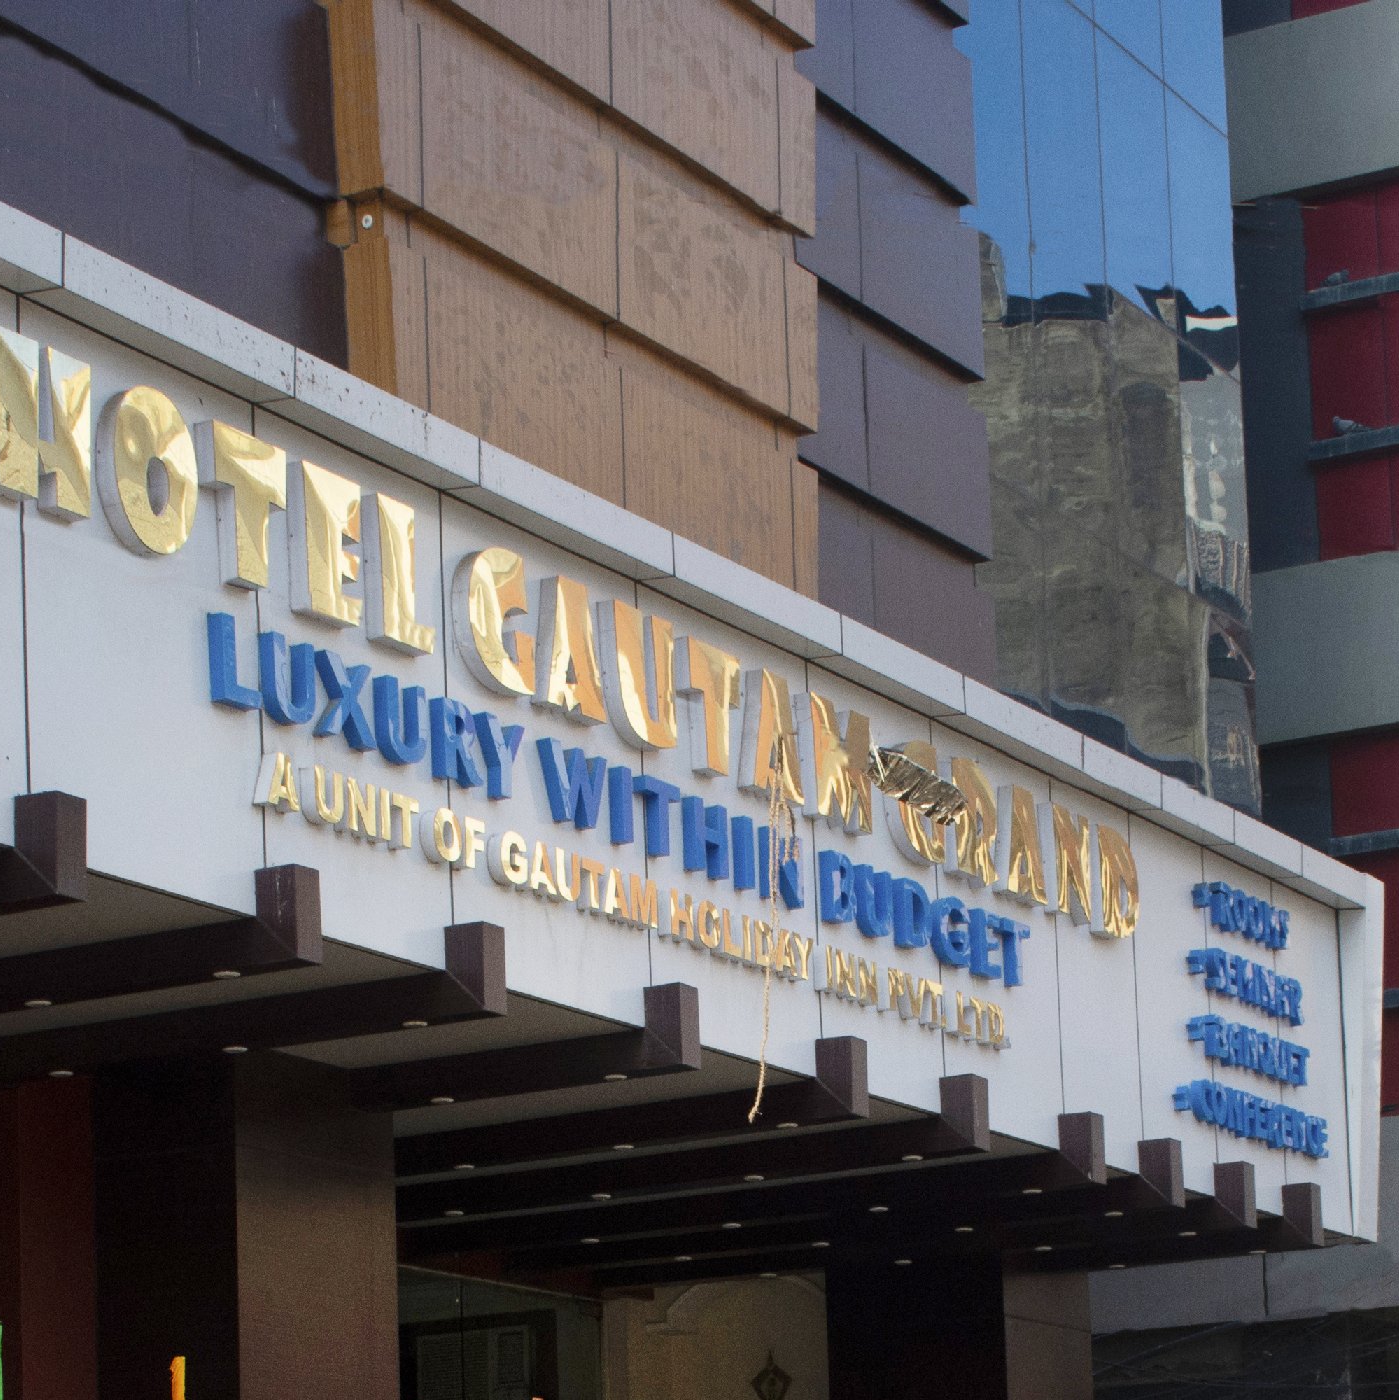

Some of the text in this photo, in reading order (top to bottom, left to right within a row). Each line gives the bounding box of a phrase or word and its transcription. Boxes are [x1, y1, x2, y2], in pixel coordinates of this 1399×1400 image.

[451, 548, 872, 836] GAUTAM
[207, 612, 1030, 987] LUXURY WITHIN BUDGET
[253, 752, 299, 813] A
[300, 764, 419, 850] UNIT
[420, 807, 485, 871] OF
[487, 831, 658, 930] GAUTAM
[658, 887, 814, 982] HOLIDAY
[813, 943, 878, 1008] INN
[1209, 881, 1289, 949] ROOMS
[1205, 947, 1304, 1026] SEMINAR
[1204, 1014, 1310, 1086] BANQUET
[1190, 1079, 1329, 1159] CONFERENCE
